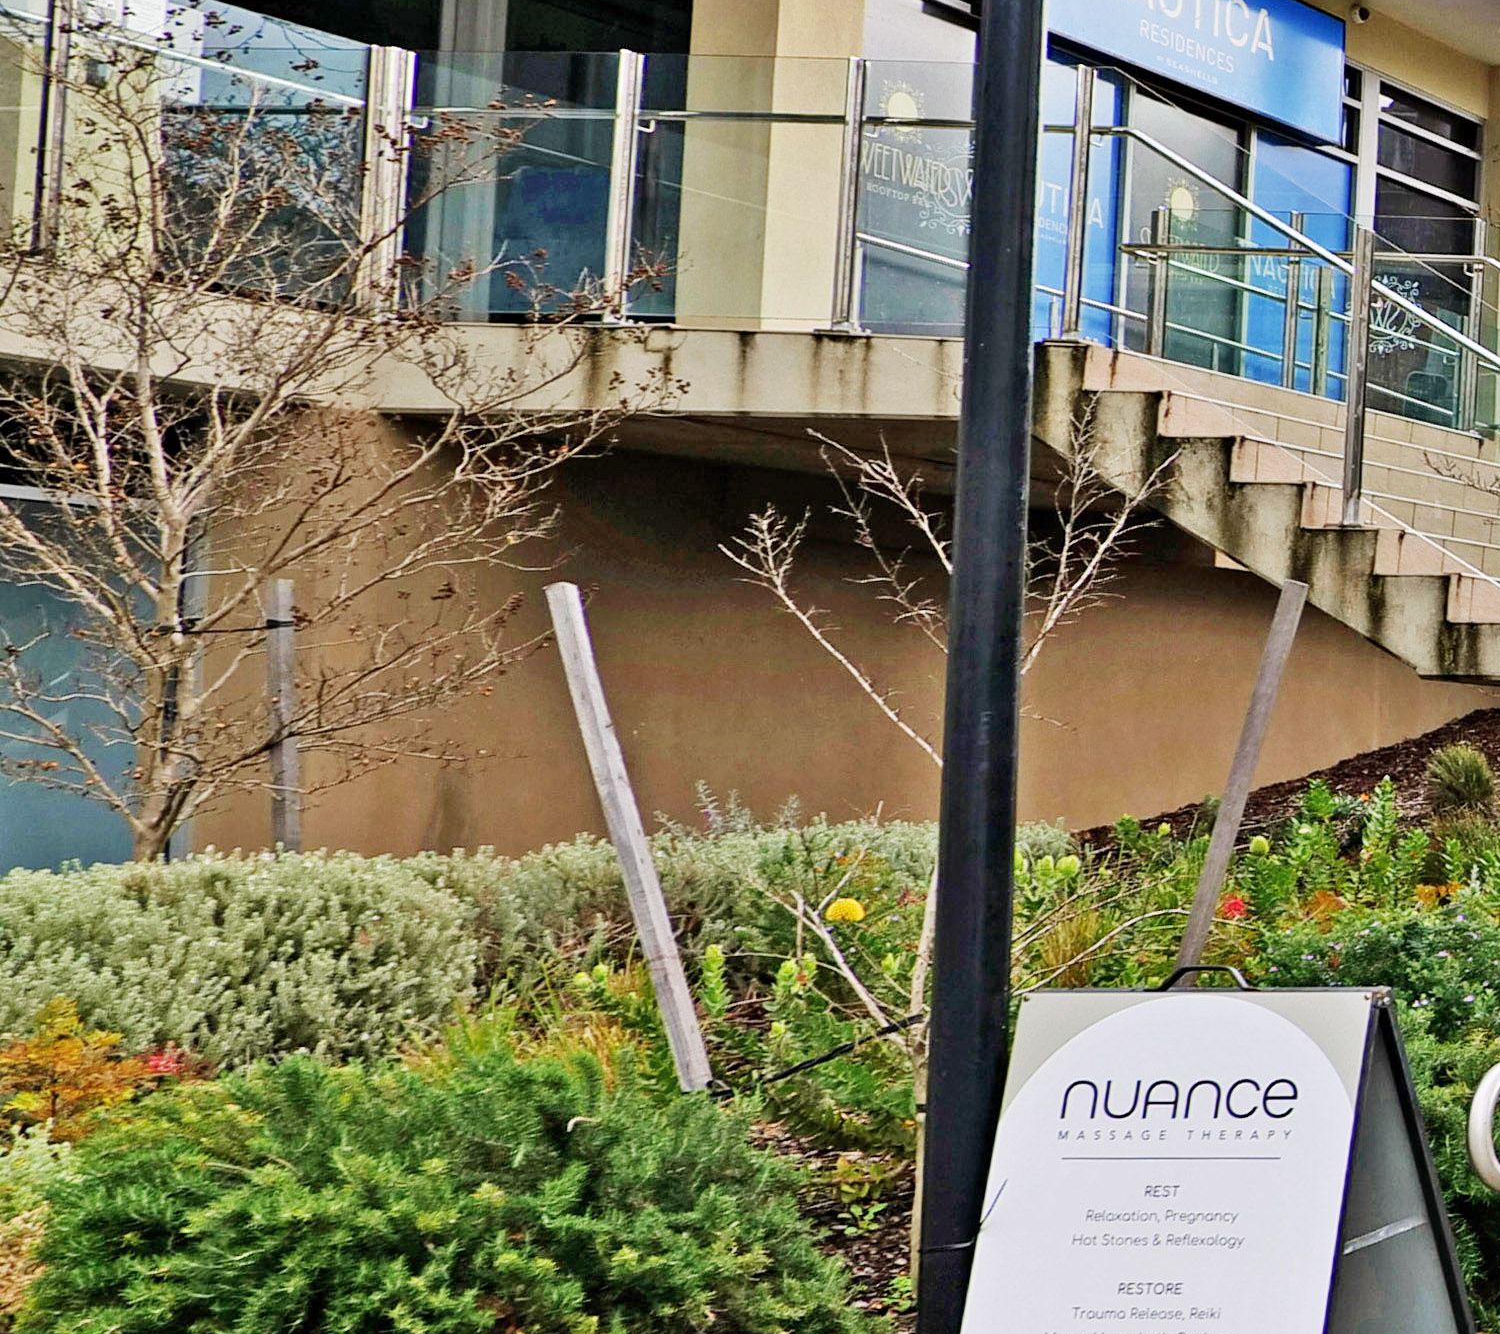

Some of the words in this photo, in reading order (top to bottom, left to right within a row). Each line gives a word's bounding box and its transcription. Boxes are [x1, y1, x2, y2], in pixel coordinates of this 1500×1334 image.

[1139, 19, 1235, 74] RESIDENCES
[1057, 1129, 1168, 1141] MASSAGE
[1186, 1129, 1293, 1141] THERAPY
[1143, 1185, 1181, 1198] REST
[1085, 1209, 1162, 1223] Relaxation,
[1164, 1209, 1240, 1225] Pregnancy
[1071, 1234, 1098, 1247] Hot
[1100, 1234, 1149, 1247] Stones
[1151, 1234, 1162, 1247] &
[1165, 1233, 1246, 1250] Reflexology
[1117, 1282, 1185, 1296] RESTORE
[1072, 1306, 1127, 1321] Trauma
[1129, 1307, 1187, 1322] Release,
[1189, 1307, 1223, 1321] Reiki
